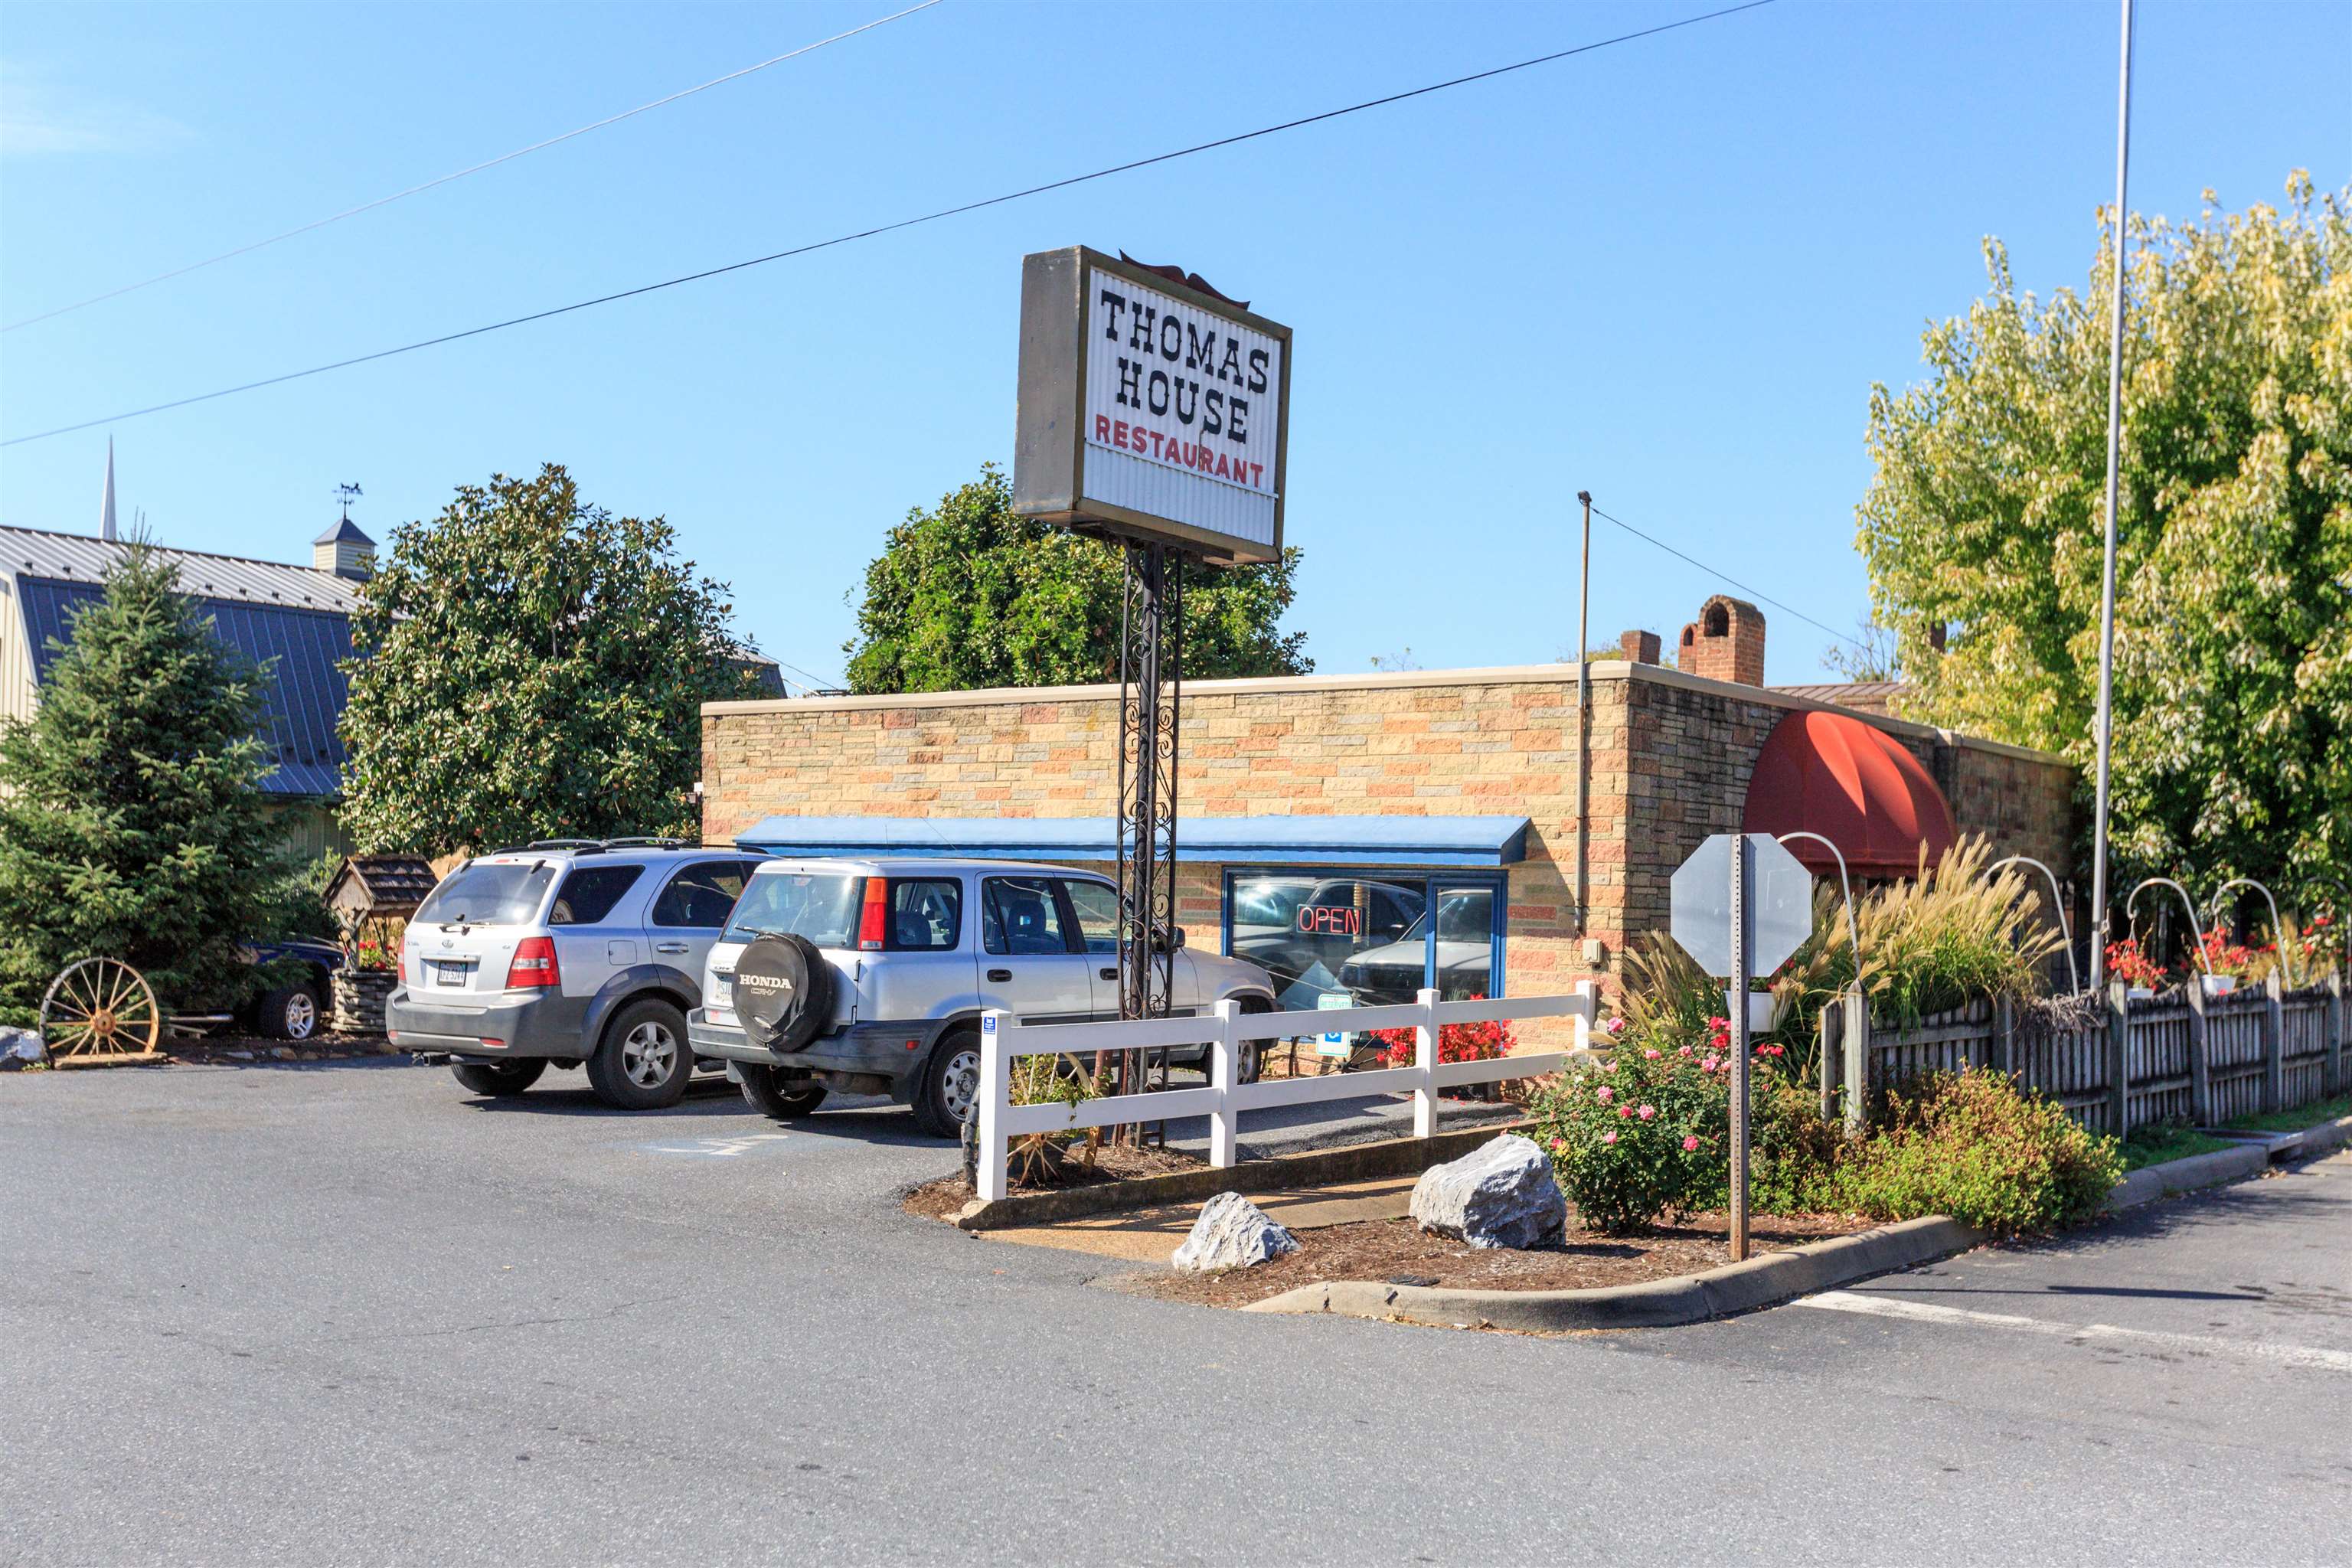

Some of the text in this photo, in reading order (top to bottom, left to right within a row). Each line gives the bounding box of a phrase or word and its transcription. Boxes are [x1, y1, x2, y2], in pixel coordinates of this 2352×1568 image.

[1101, 289, 1269, 394] THOMAS
[1116, 356, 1249, 445] HOUSE
[1096, 413, 1263, 488] RESTAURANT
[1299, 906, 1361, 935] OPEN
[739, 974, 792, 989] HONDA
[750, 987, 776, 996] CR-V
